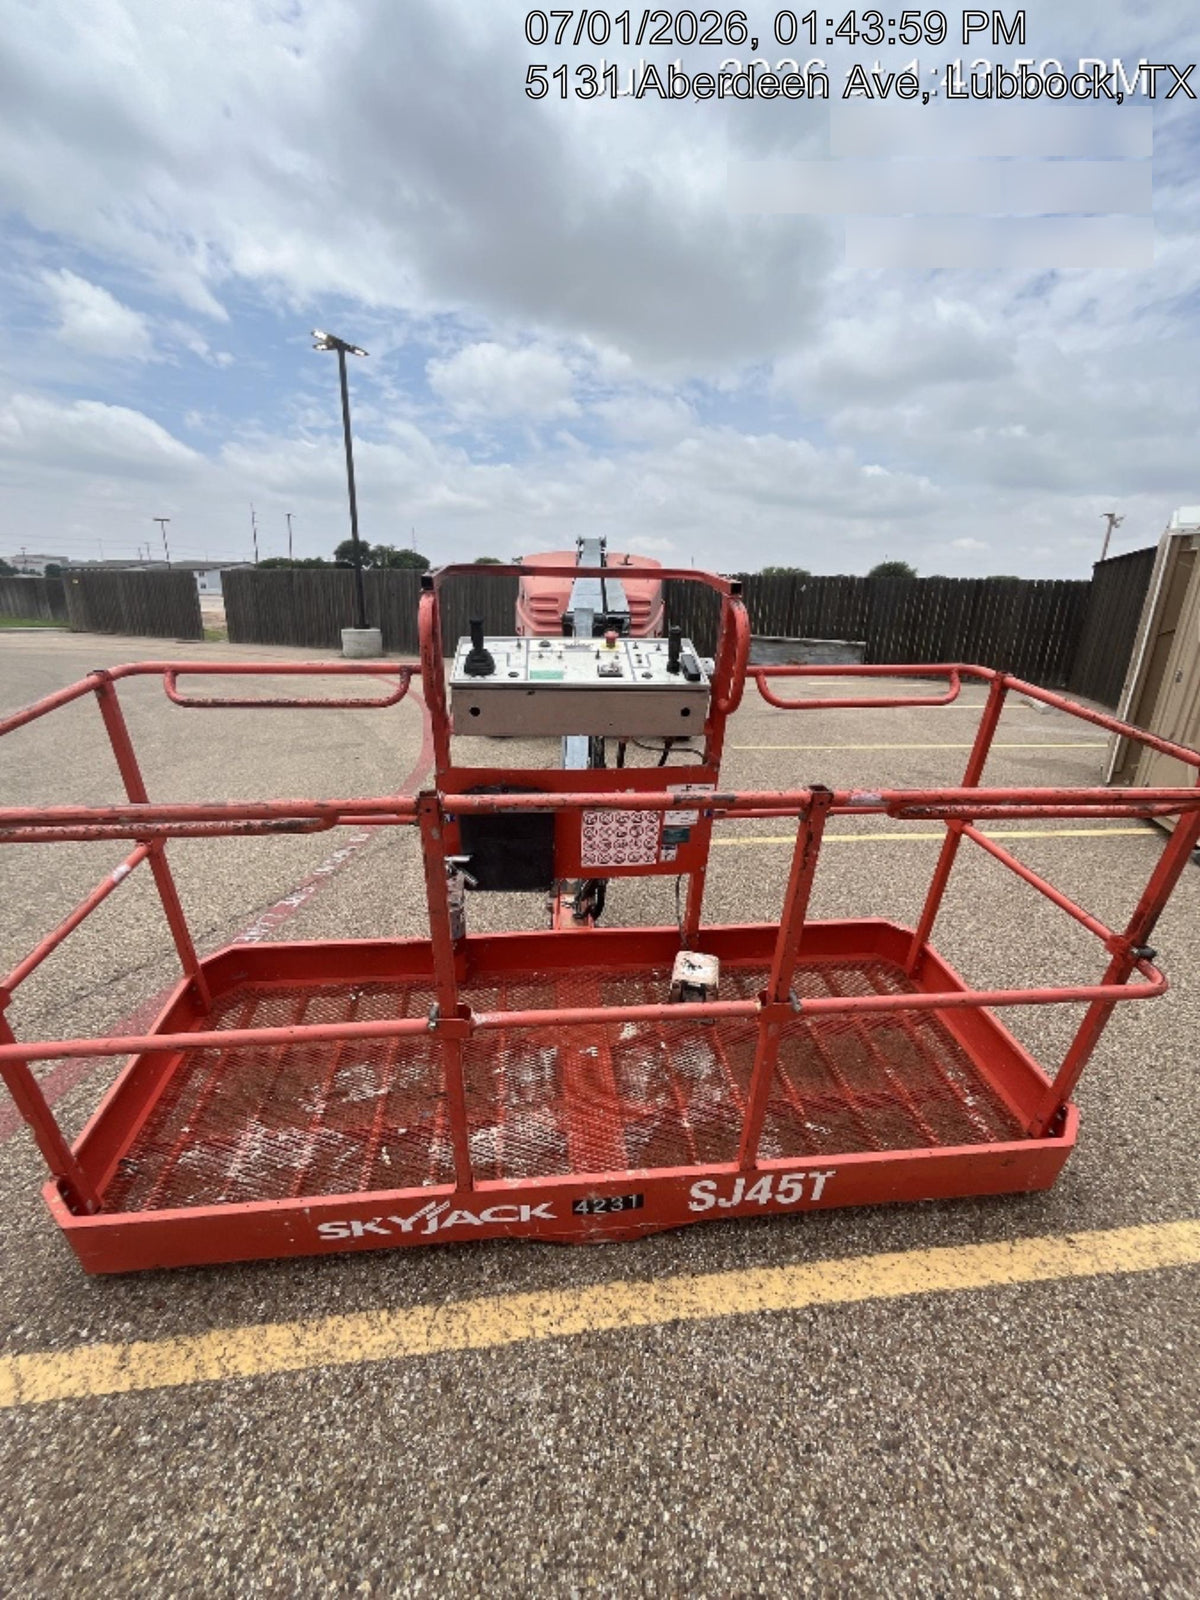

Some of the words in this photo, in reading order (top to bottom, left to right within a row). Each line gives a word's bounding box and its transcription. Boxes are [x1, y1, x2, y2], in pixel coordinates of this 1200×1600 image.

[573, 1195, 638, 1214] 4231
[688, 1171, 836, 1212] SJ45T
[317, 1200, 557, 1240] SKYJACK
